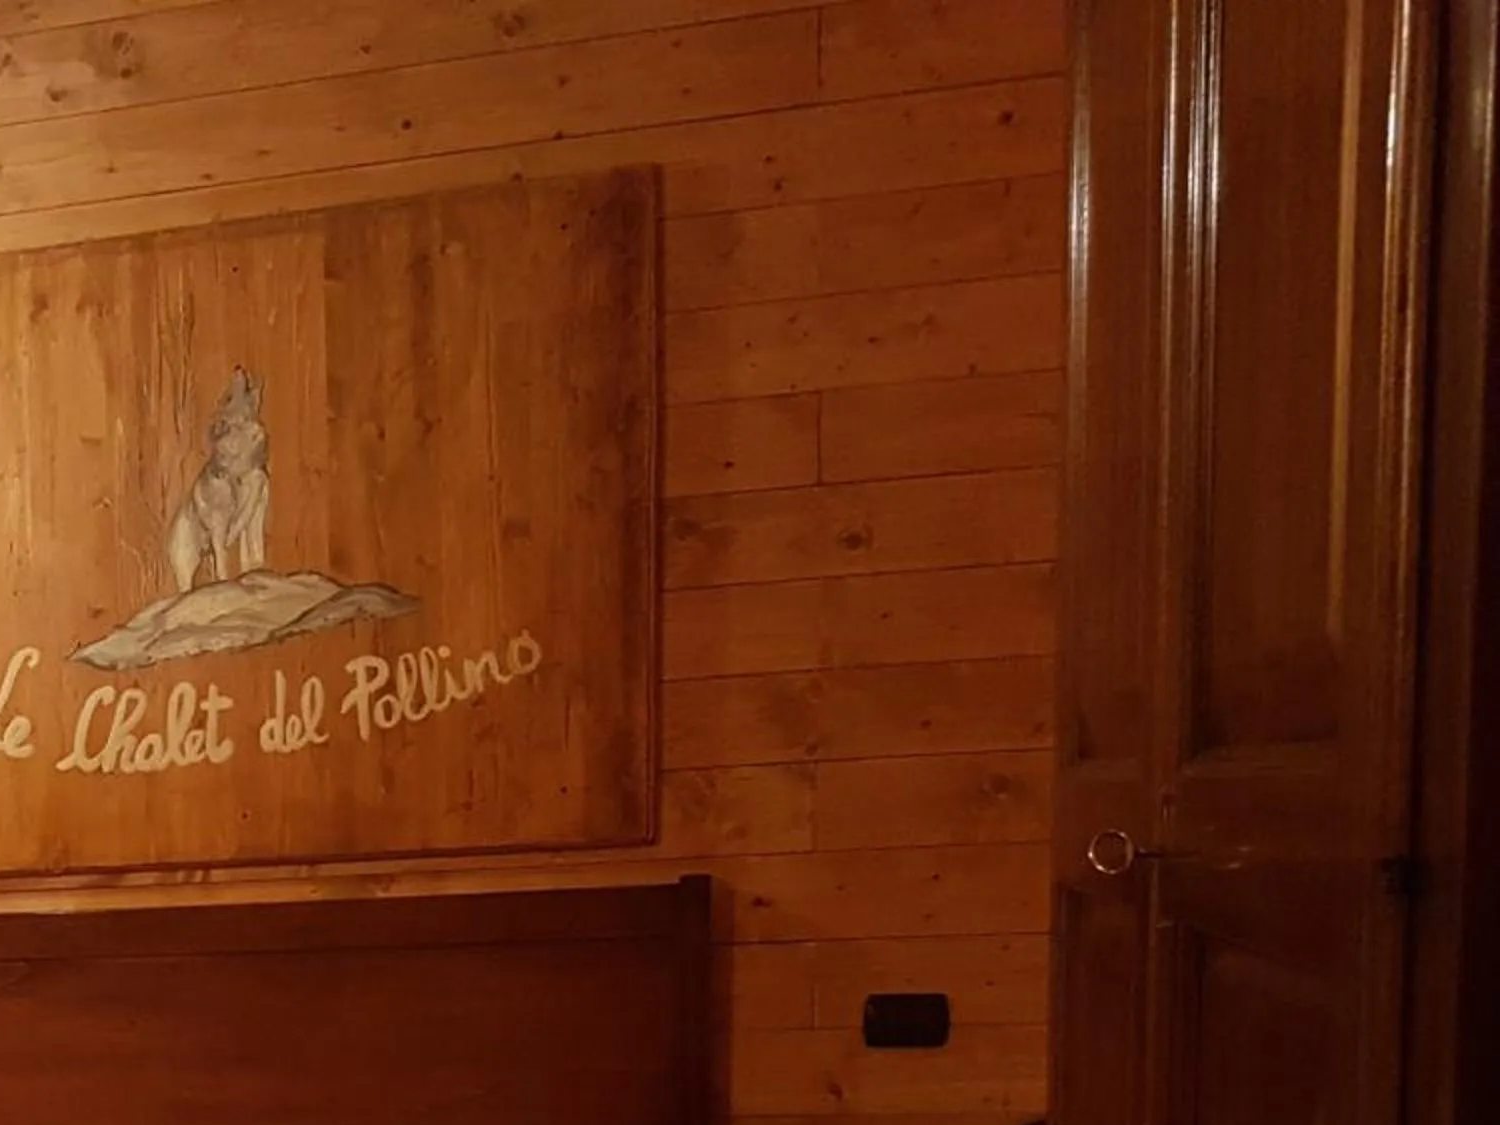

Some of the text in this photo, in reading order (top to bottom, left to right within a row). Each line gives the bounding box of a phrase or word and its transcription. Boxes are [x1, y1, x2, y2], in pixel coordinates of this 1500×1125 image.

[56, 682, 234, 774] Chalet
[259, 669, 329, 753] del
[341, 629, 543, 741] Pollino
